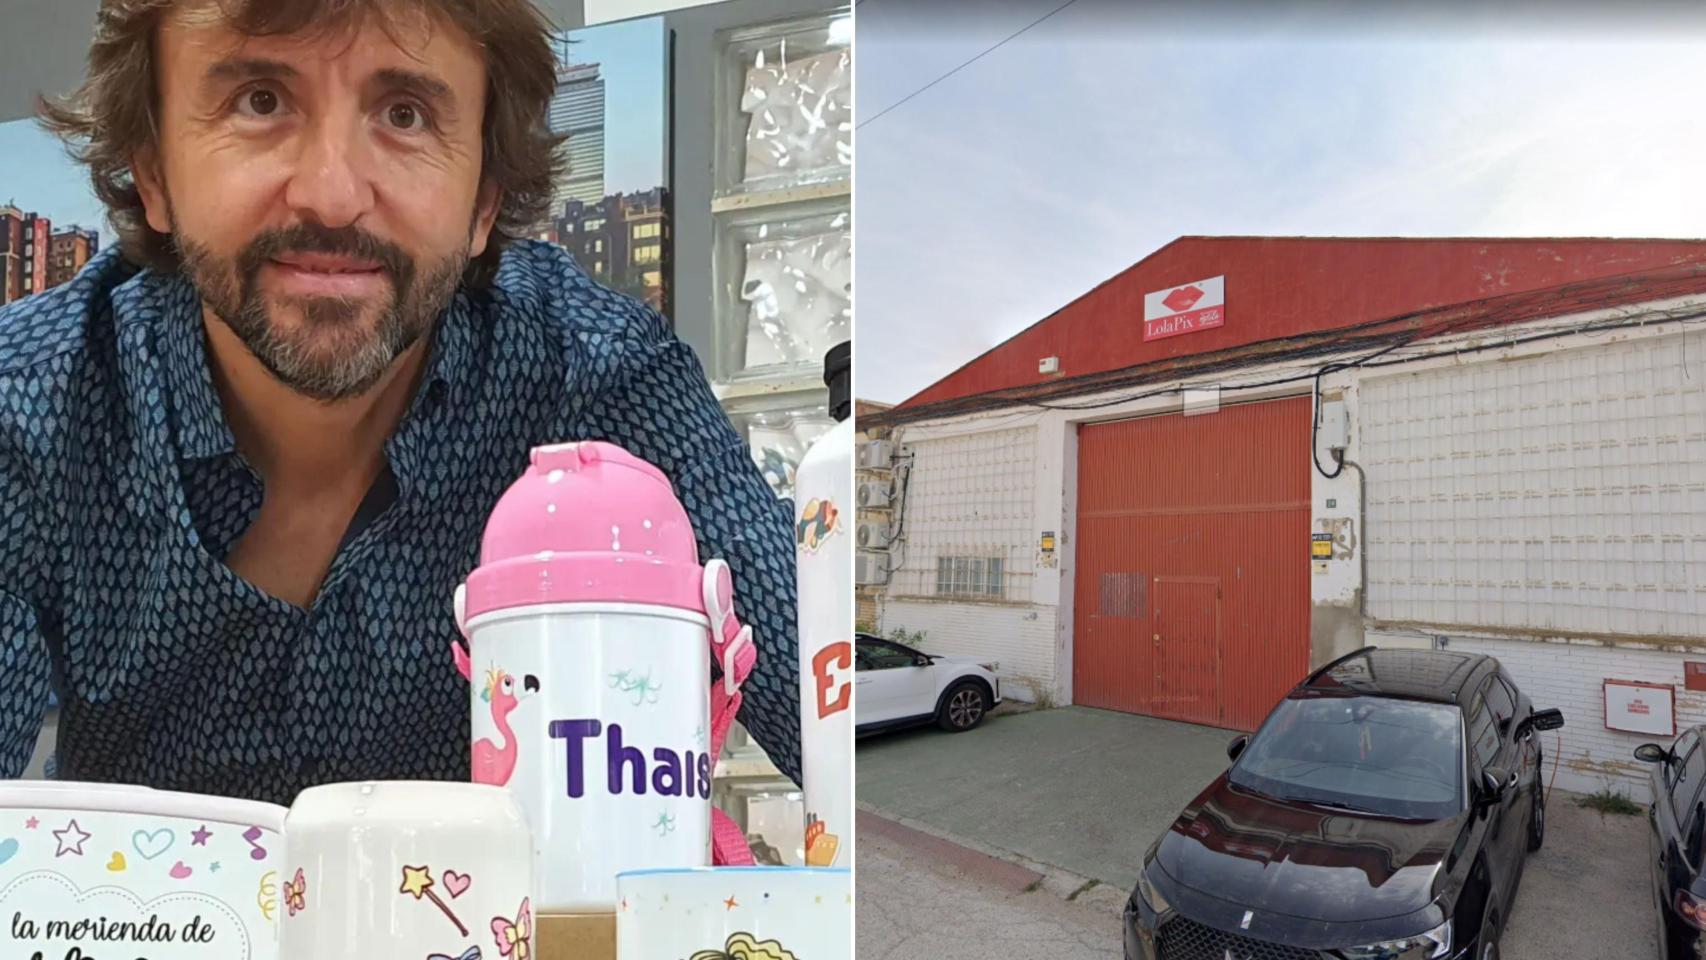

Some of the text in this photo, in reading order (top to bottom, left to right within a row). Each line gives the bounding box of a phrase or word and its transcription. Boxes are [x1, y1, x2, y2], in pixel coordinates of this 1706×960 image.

[11, 911, 215, 943] la merienda de
